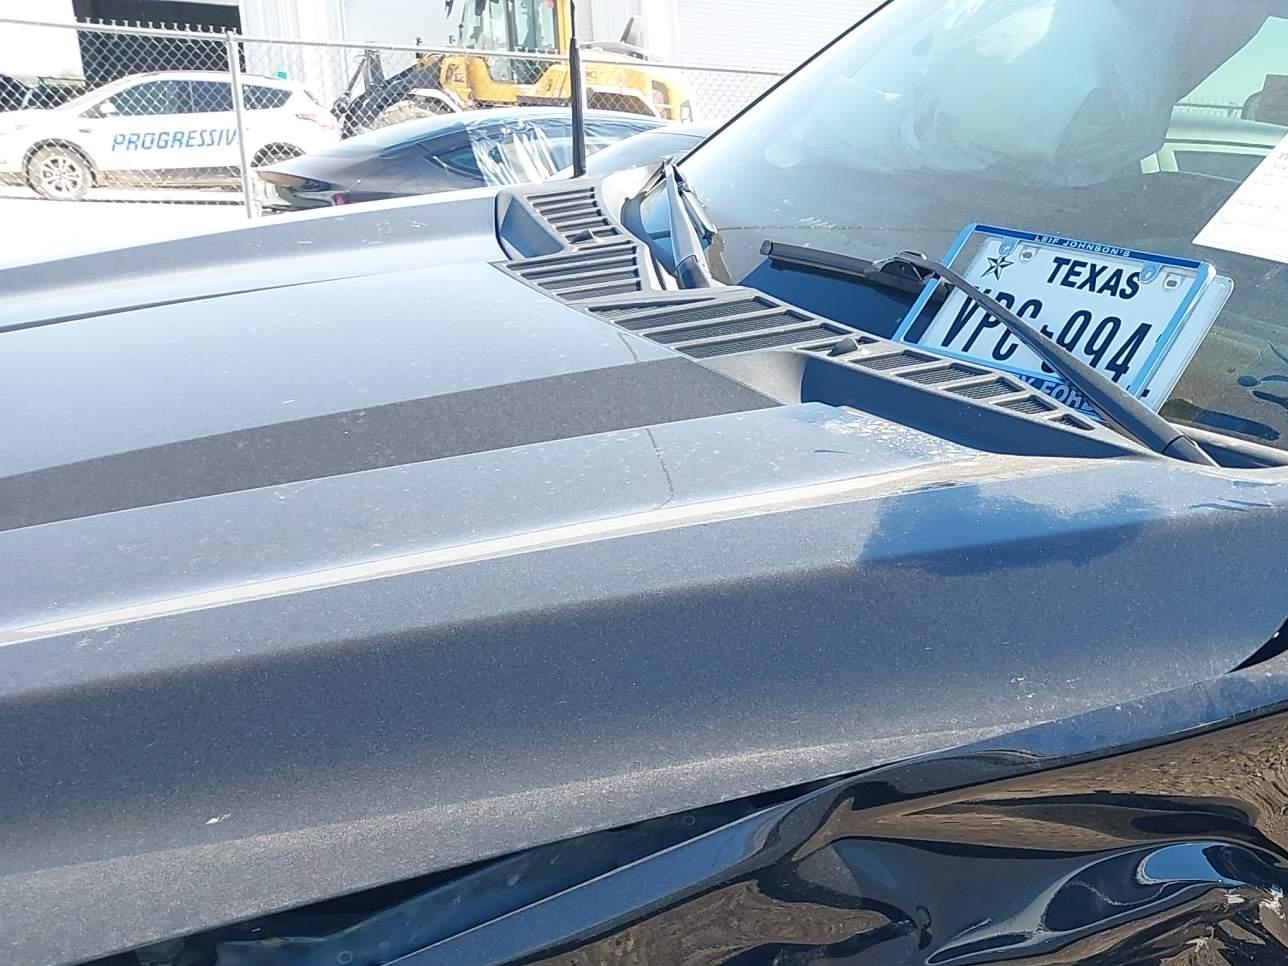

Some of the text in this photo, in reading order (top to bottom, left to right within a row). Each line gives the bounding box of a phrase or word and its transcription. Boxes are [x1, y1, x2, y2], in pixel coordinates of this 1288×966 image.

[112, 128, 240, 151] PROGRESSIV
[1033, 235, 1059, 243] LEIF
[1047, 256, 1140, 299] TEXAS
